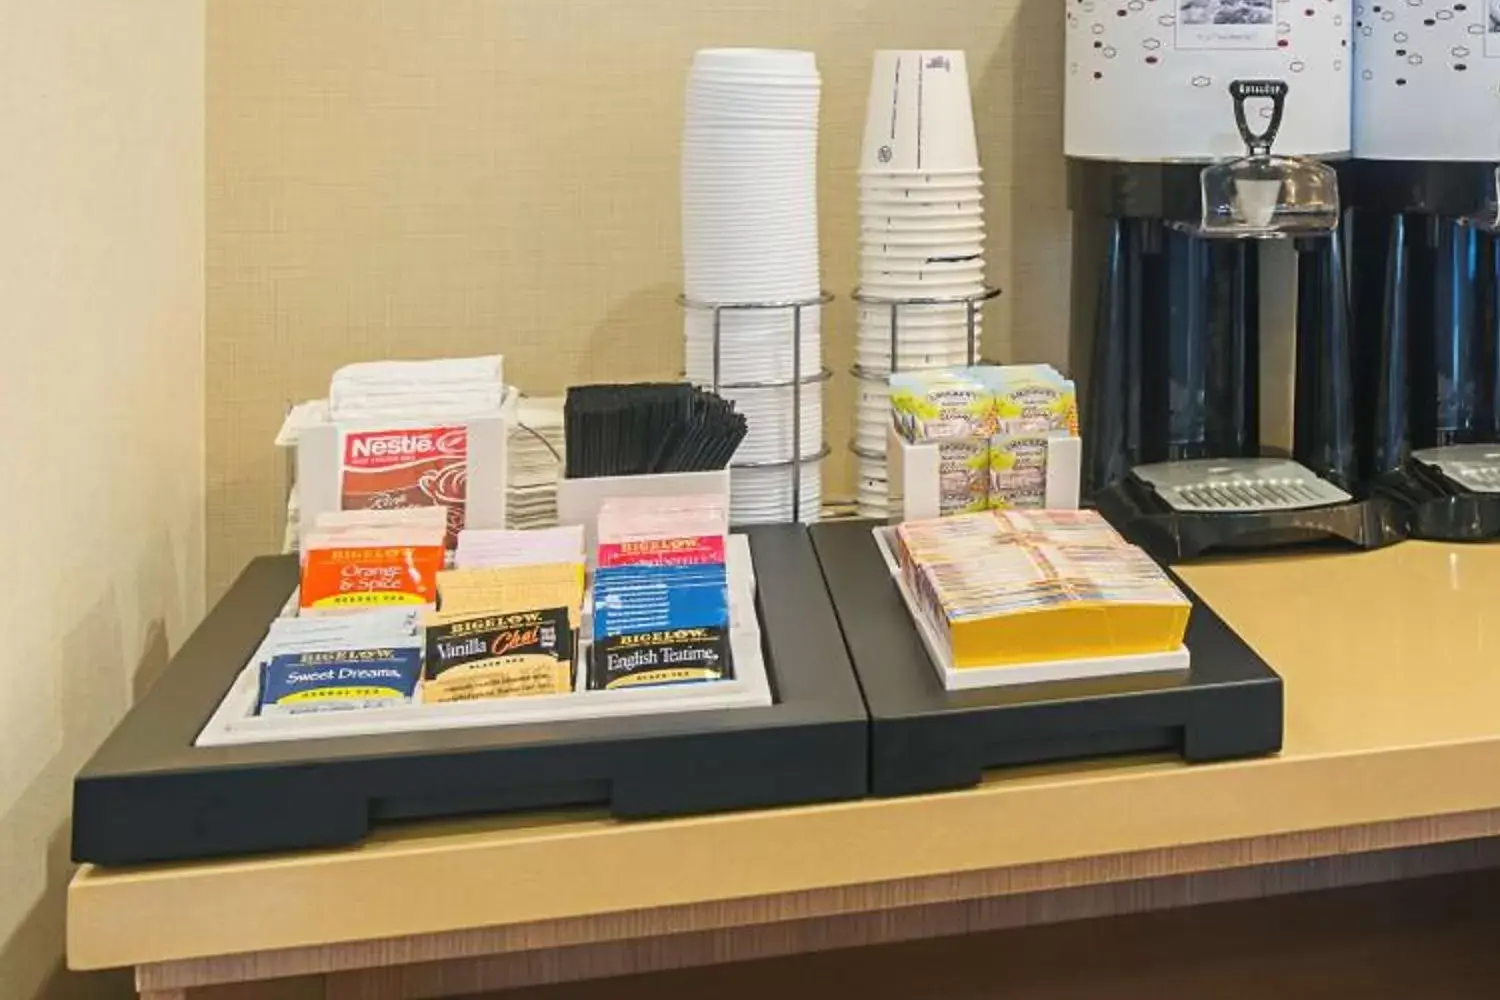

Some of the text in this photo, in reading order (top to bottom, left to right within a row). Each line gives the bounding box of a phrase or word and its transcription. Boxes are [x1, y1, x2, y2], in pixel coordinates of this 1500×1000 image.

[450, 612, 541, 635] BIGELOW
[437, 637, 487, 660] Vanilla
[492, 625, 540, 656] Chai
[607, 648, 658, 671] English
[285, 669, 336, 685] Sweet
